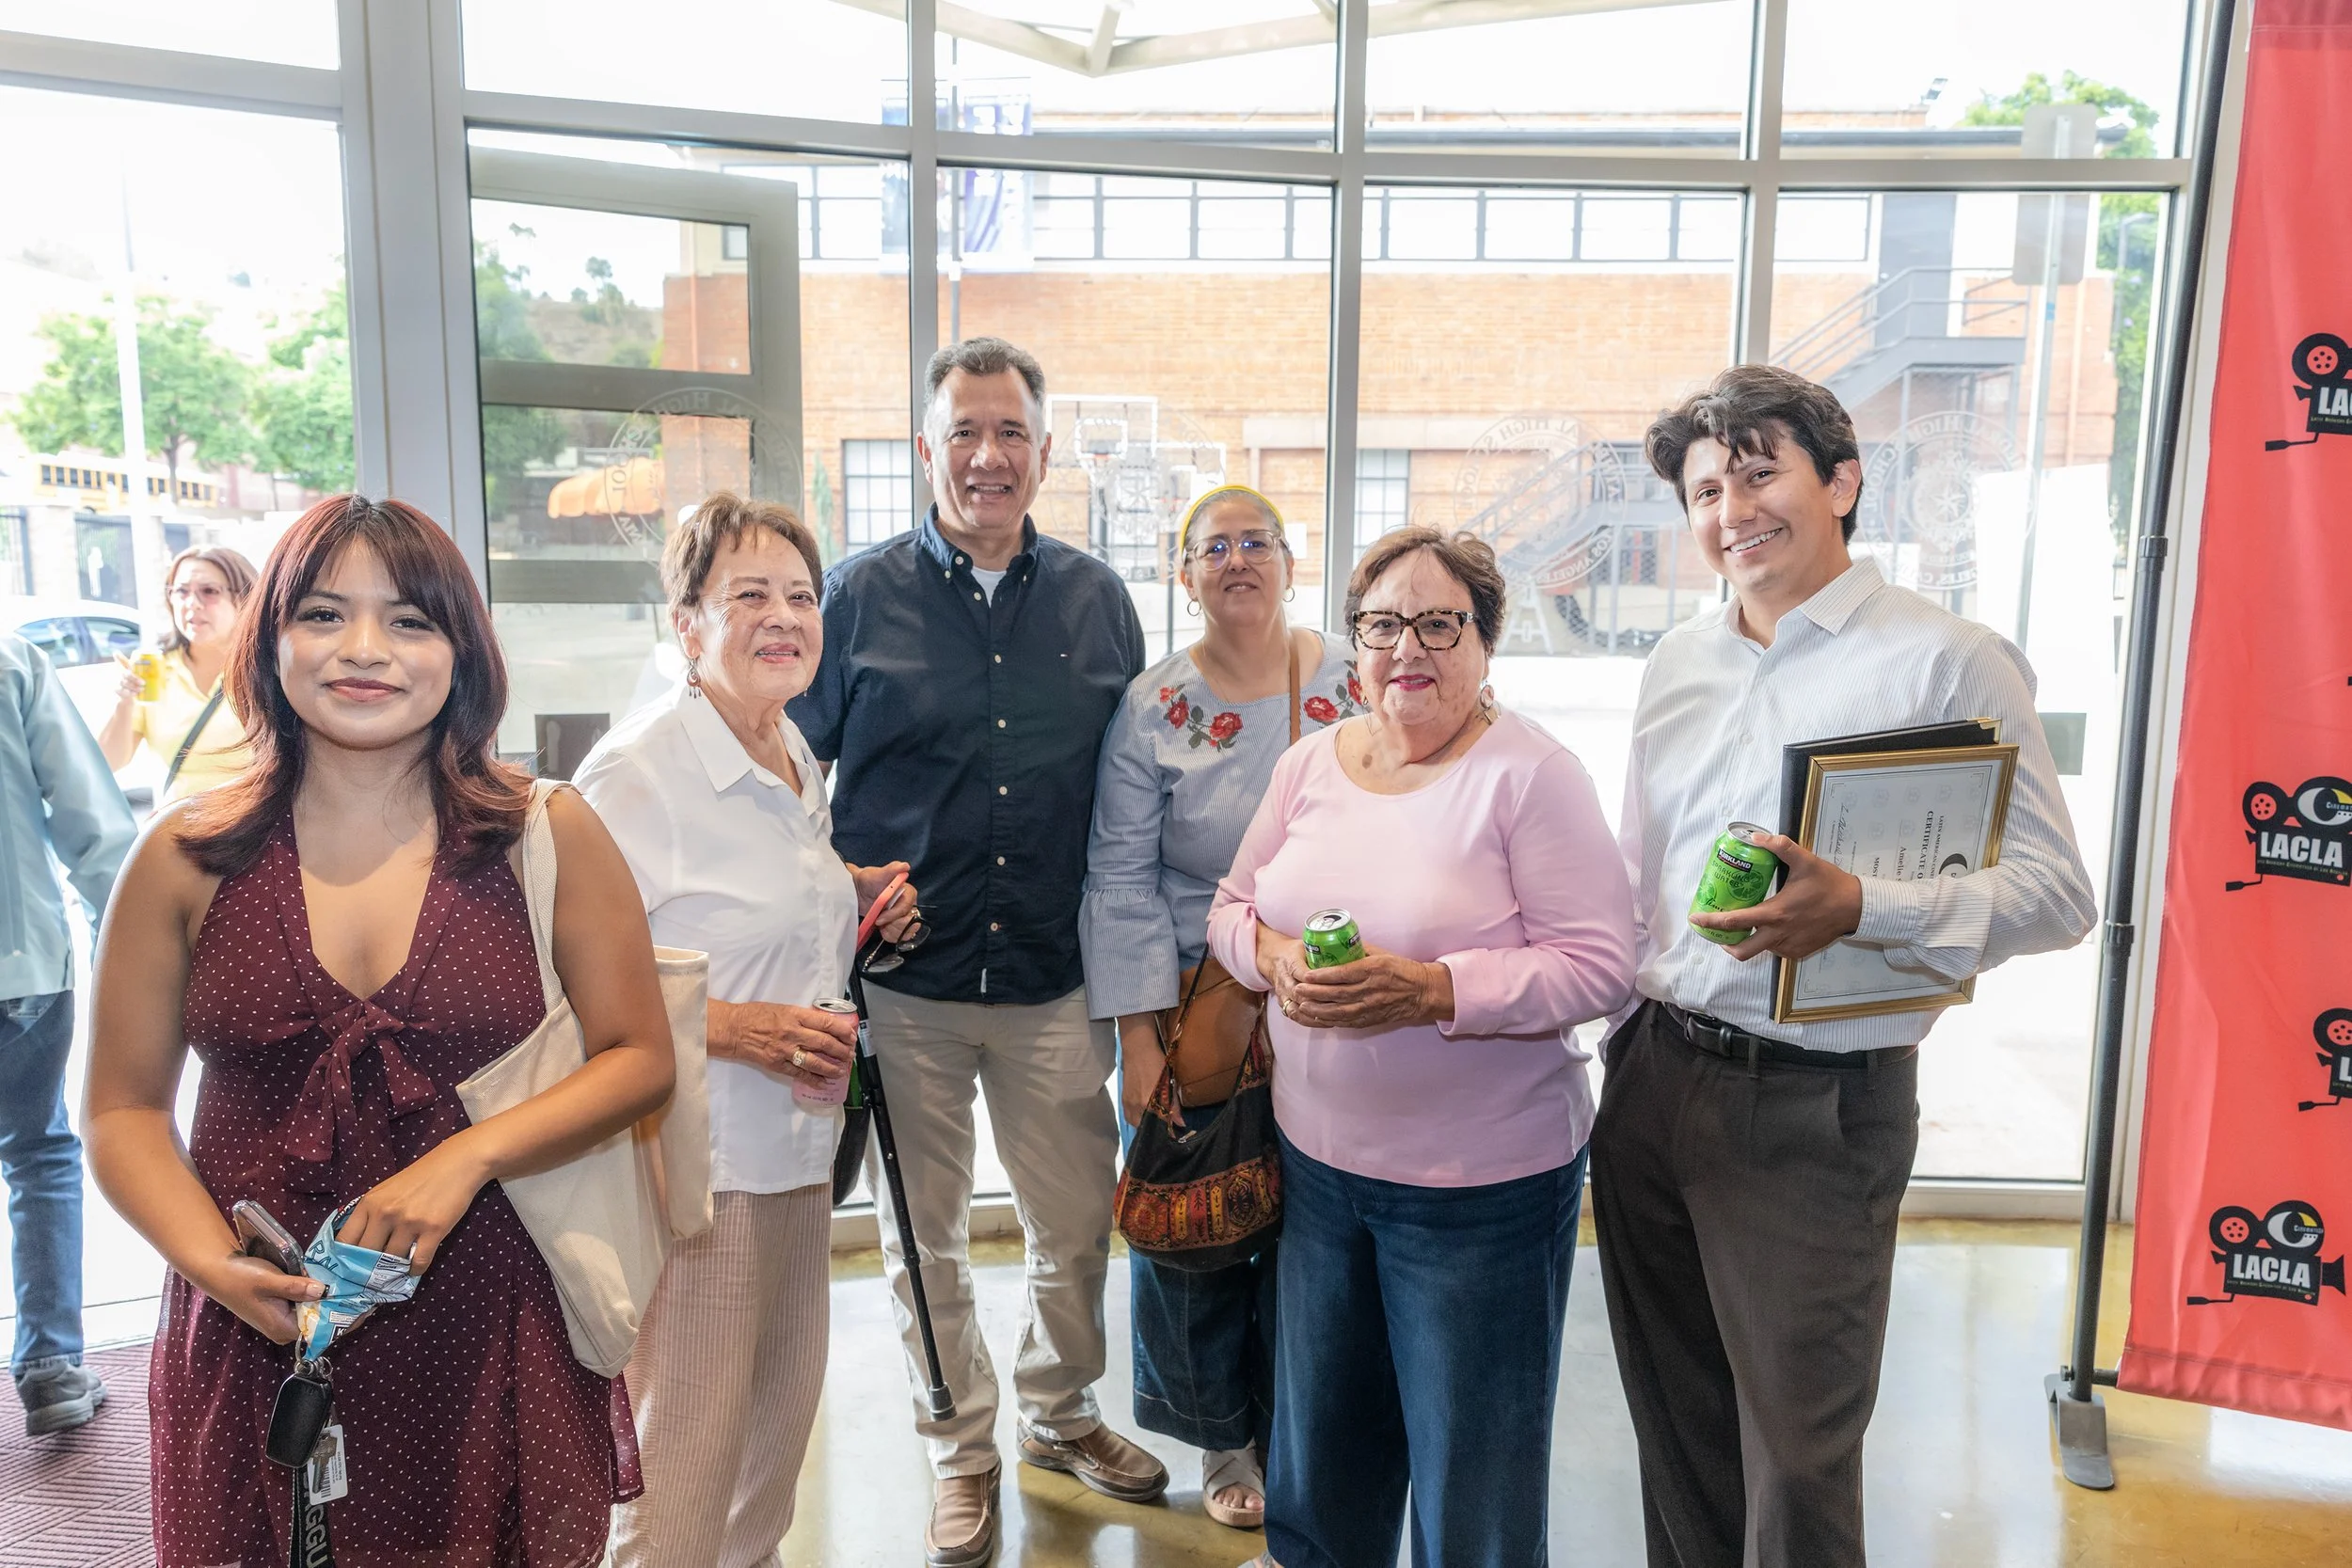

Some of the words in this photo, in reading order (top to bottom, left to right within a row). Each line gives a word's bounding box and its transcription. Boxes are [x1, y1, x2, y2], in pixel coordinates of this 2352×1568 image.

[1918, 811, 1934, 870] CERTIFICATE
[1931, 833, 1942, 863] AMERICAN
[2260, 832, 2343, 868] LACLA
[1712, 861, 1751, 882] SPARKLING
[1718, 848, 1752, 870] KIRKLAND
[1896, 847, 1907, 876] Amelie
[1714, 871, 1740, 888] WATER
[2233, 1253, 2312, 1289] LACLA
